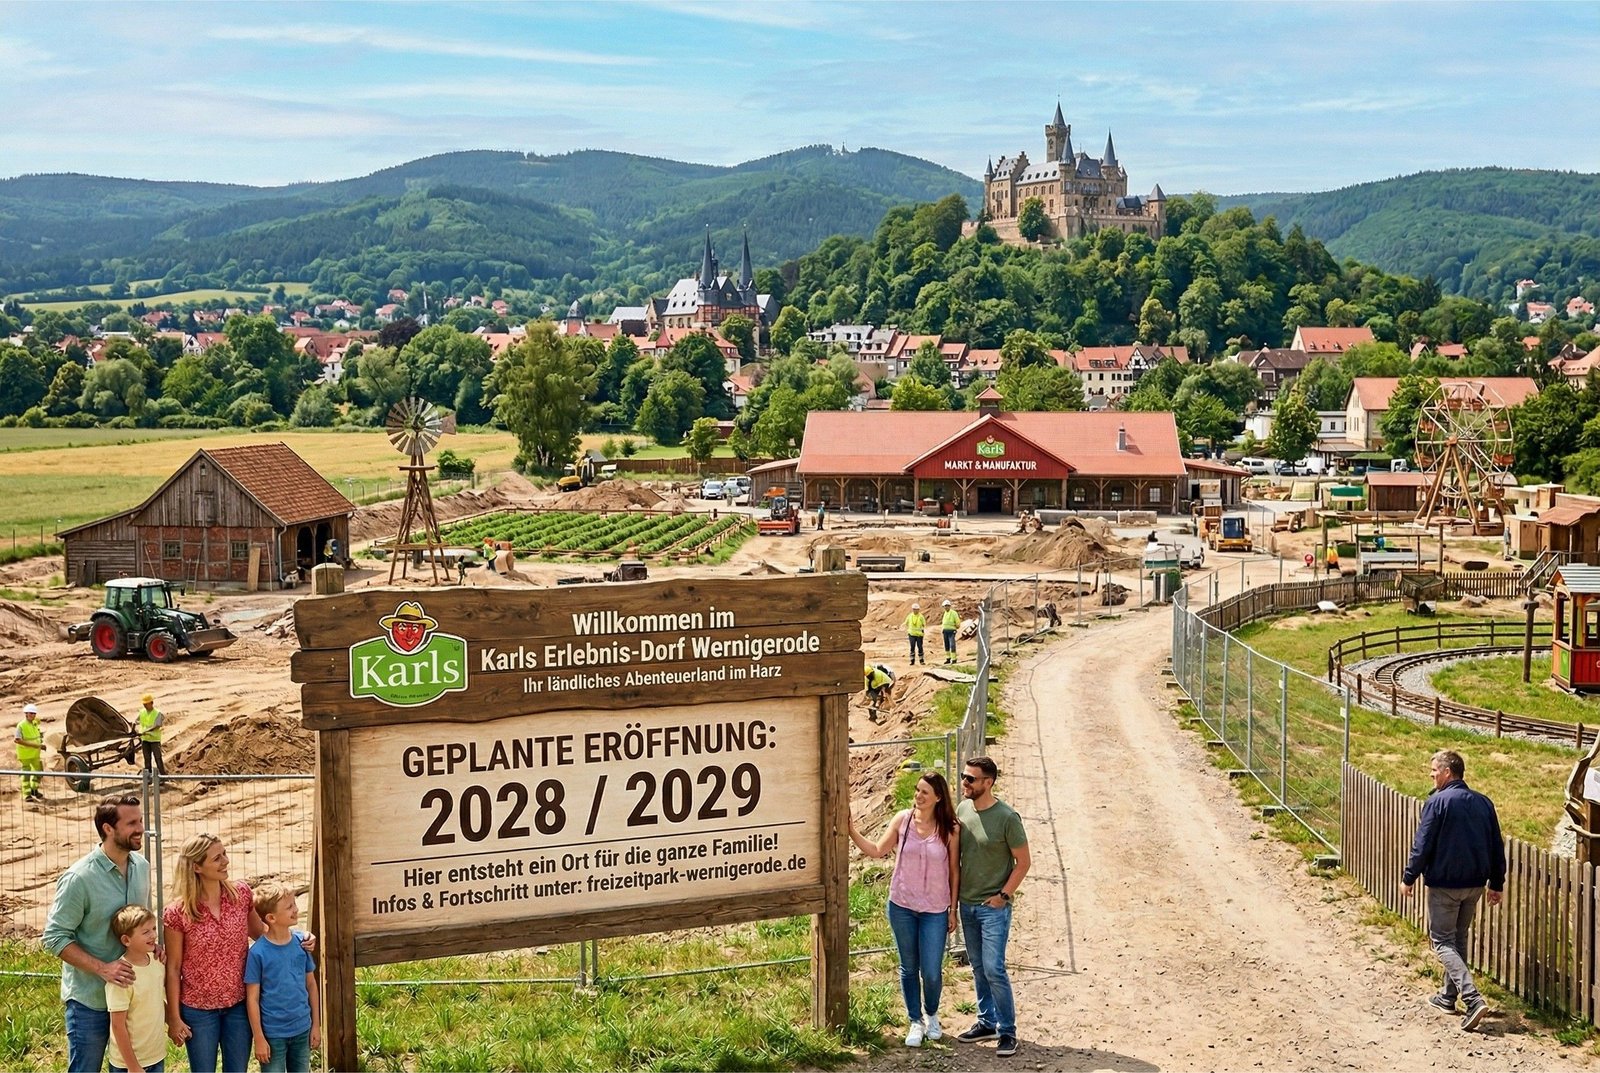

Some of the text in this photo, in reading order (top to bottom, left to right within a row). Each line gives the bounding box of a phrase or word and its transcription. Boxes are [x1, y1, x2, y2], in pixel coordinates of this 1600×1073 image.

[945, 461, 1037, 470] MARKT & MANUFAKTUR
[978, 443, 1003, 455] Karls
[573, 608, 734, 636] Willkommen im
[358, 650, 459, 688] Karls
[481, 632, 820, 671] Karls Erlebnis-Dorf Wernigerode
[524, 663, 782, 693] Ihr ländliches Abenteuerland im Harz
[402, 720, 776, 778] GEPLANTE ERÖFFNUNG:
[421, 762, 761, 846] 2028 / 2029
[403, 833, 778, 887] Hier entsteht ein Ort für die ganze Familie!
[372, 854, 806, 915] Infos & Fortschritt unter: freizeitpark-wernigerode.de
